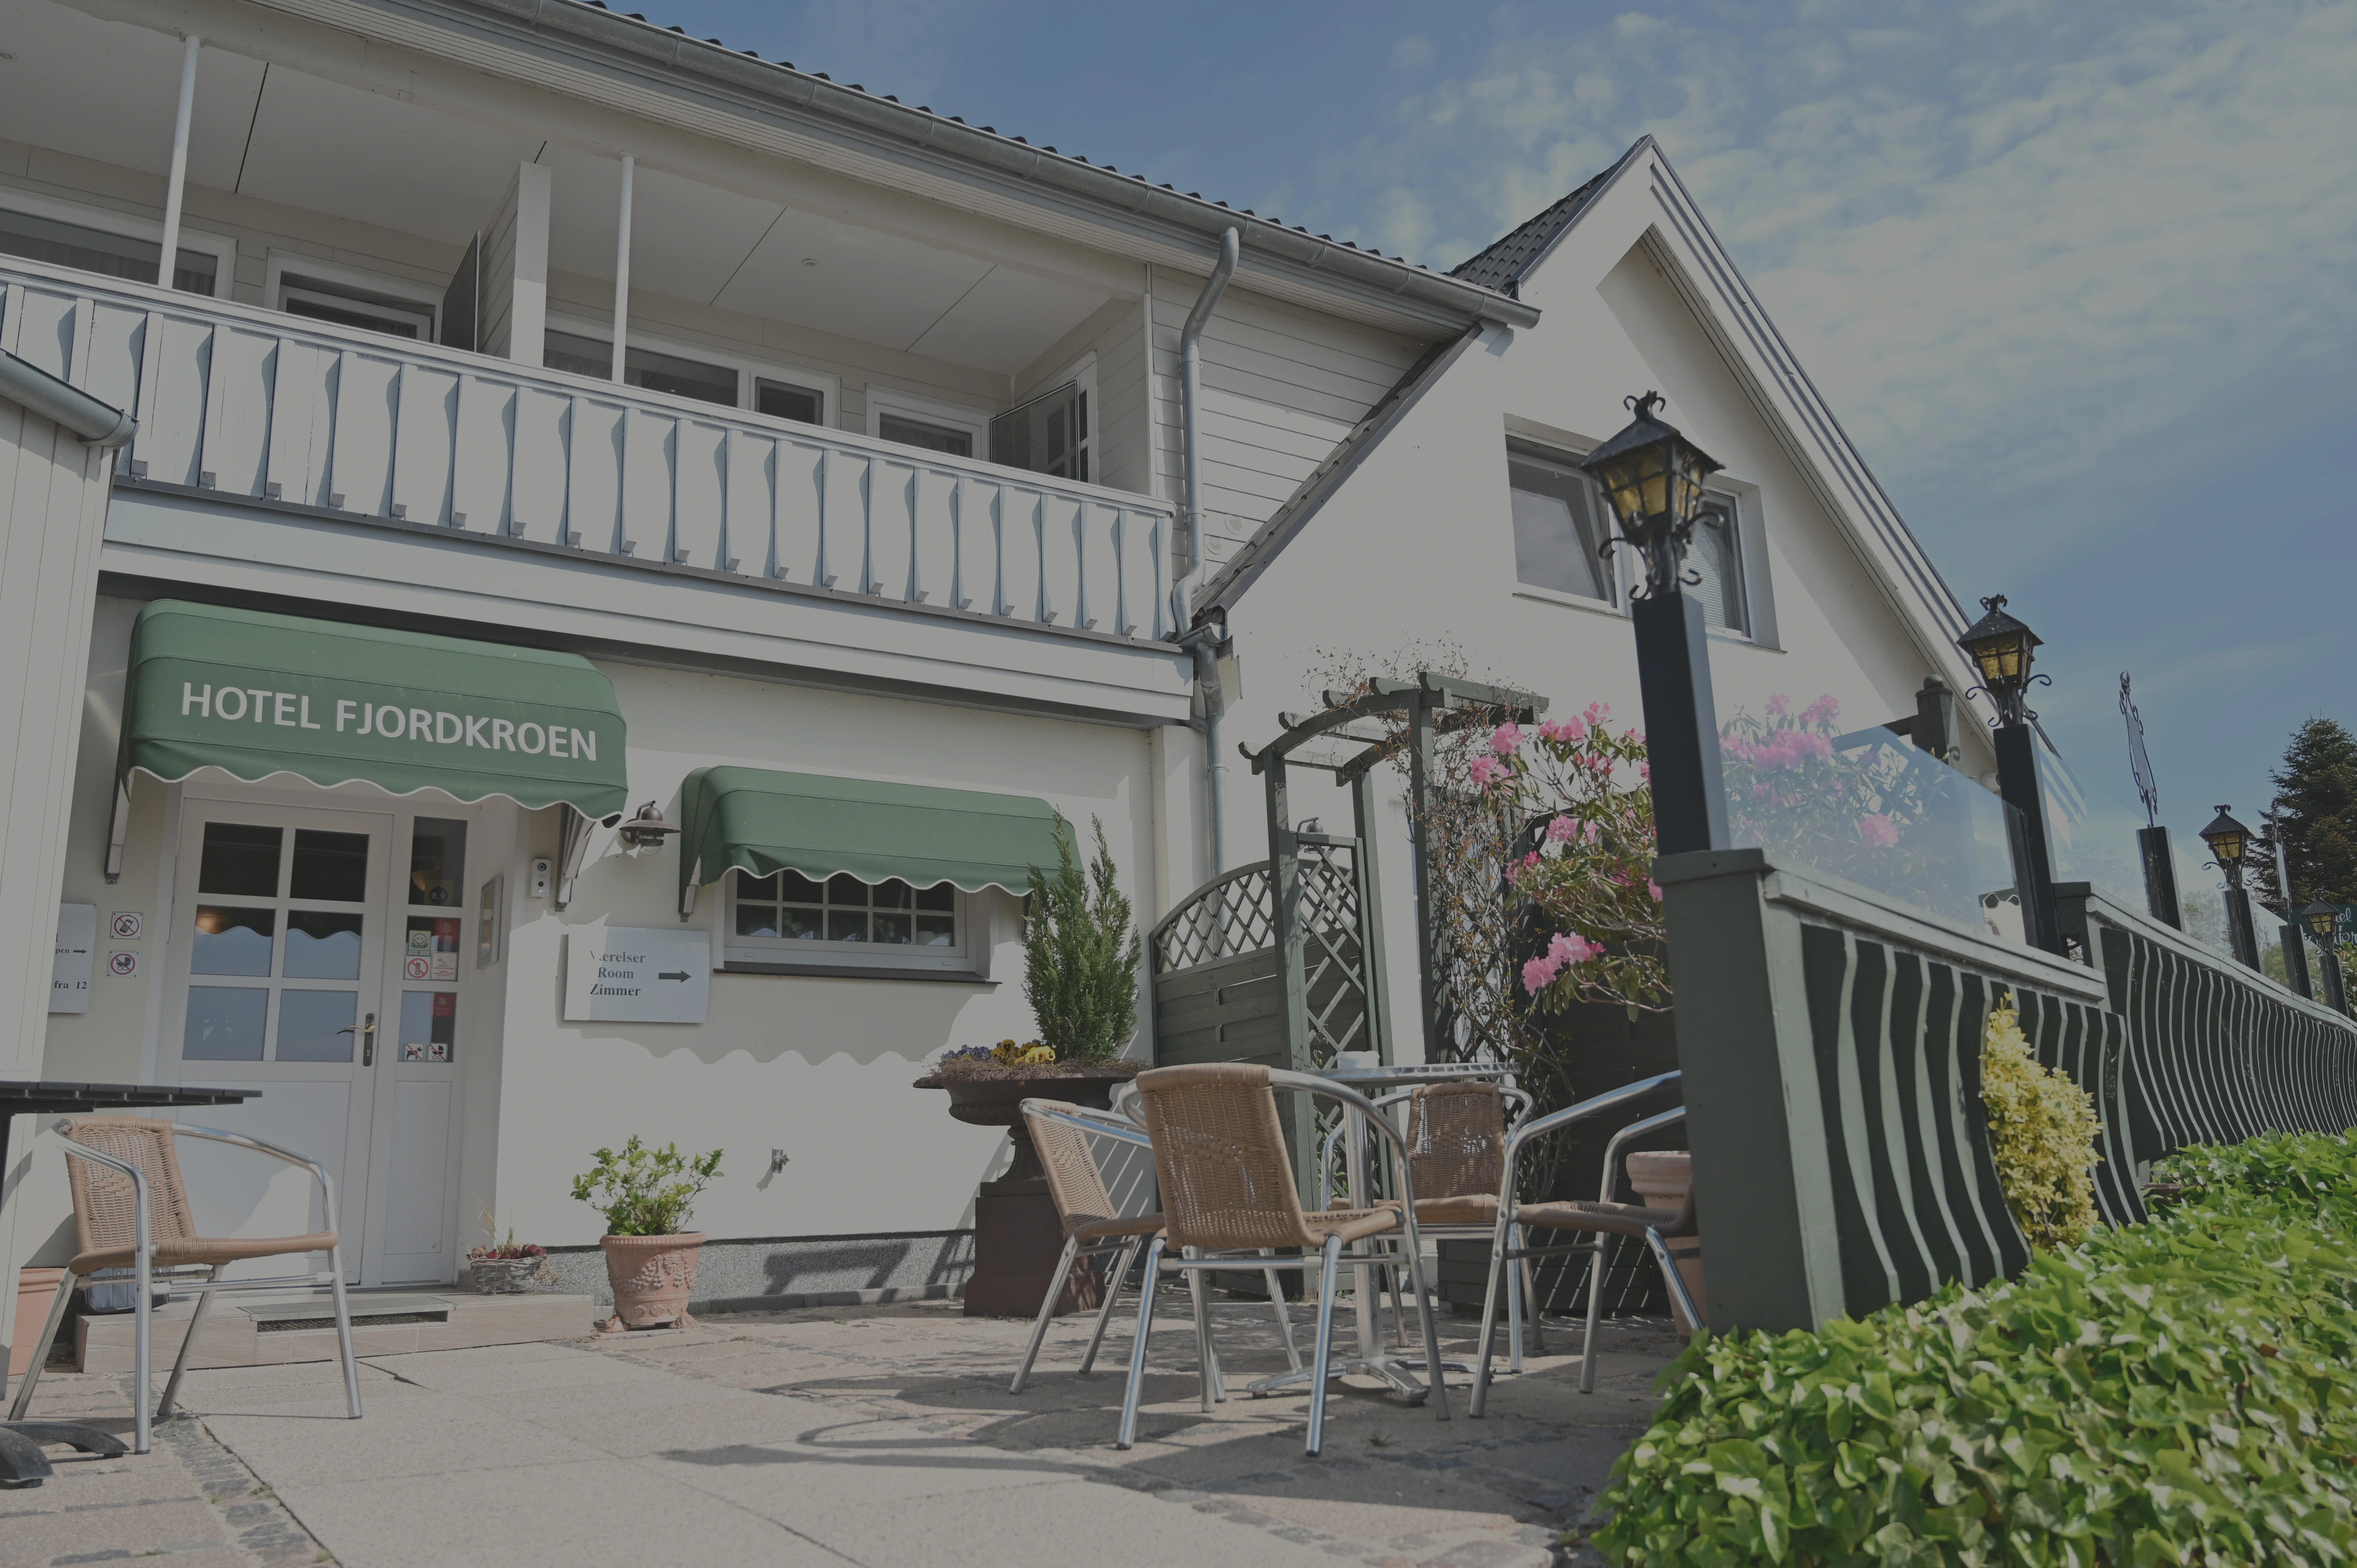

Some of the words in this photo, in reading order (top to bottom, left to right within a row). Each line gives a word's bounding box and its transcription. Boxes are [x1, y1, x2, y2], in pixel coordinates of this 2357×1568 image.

[182, 682, 321, 730] HOTEL
[336, 699, 597, 762] FJORDKROEN
[432, 892, 446, 900] 8,9
[598, 967, 633, 978] Room
[54, 980, 69, 989] fra
[590, 984, 641, 995] Zimmer
